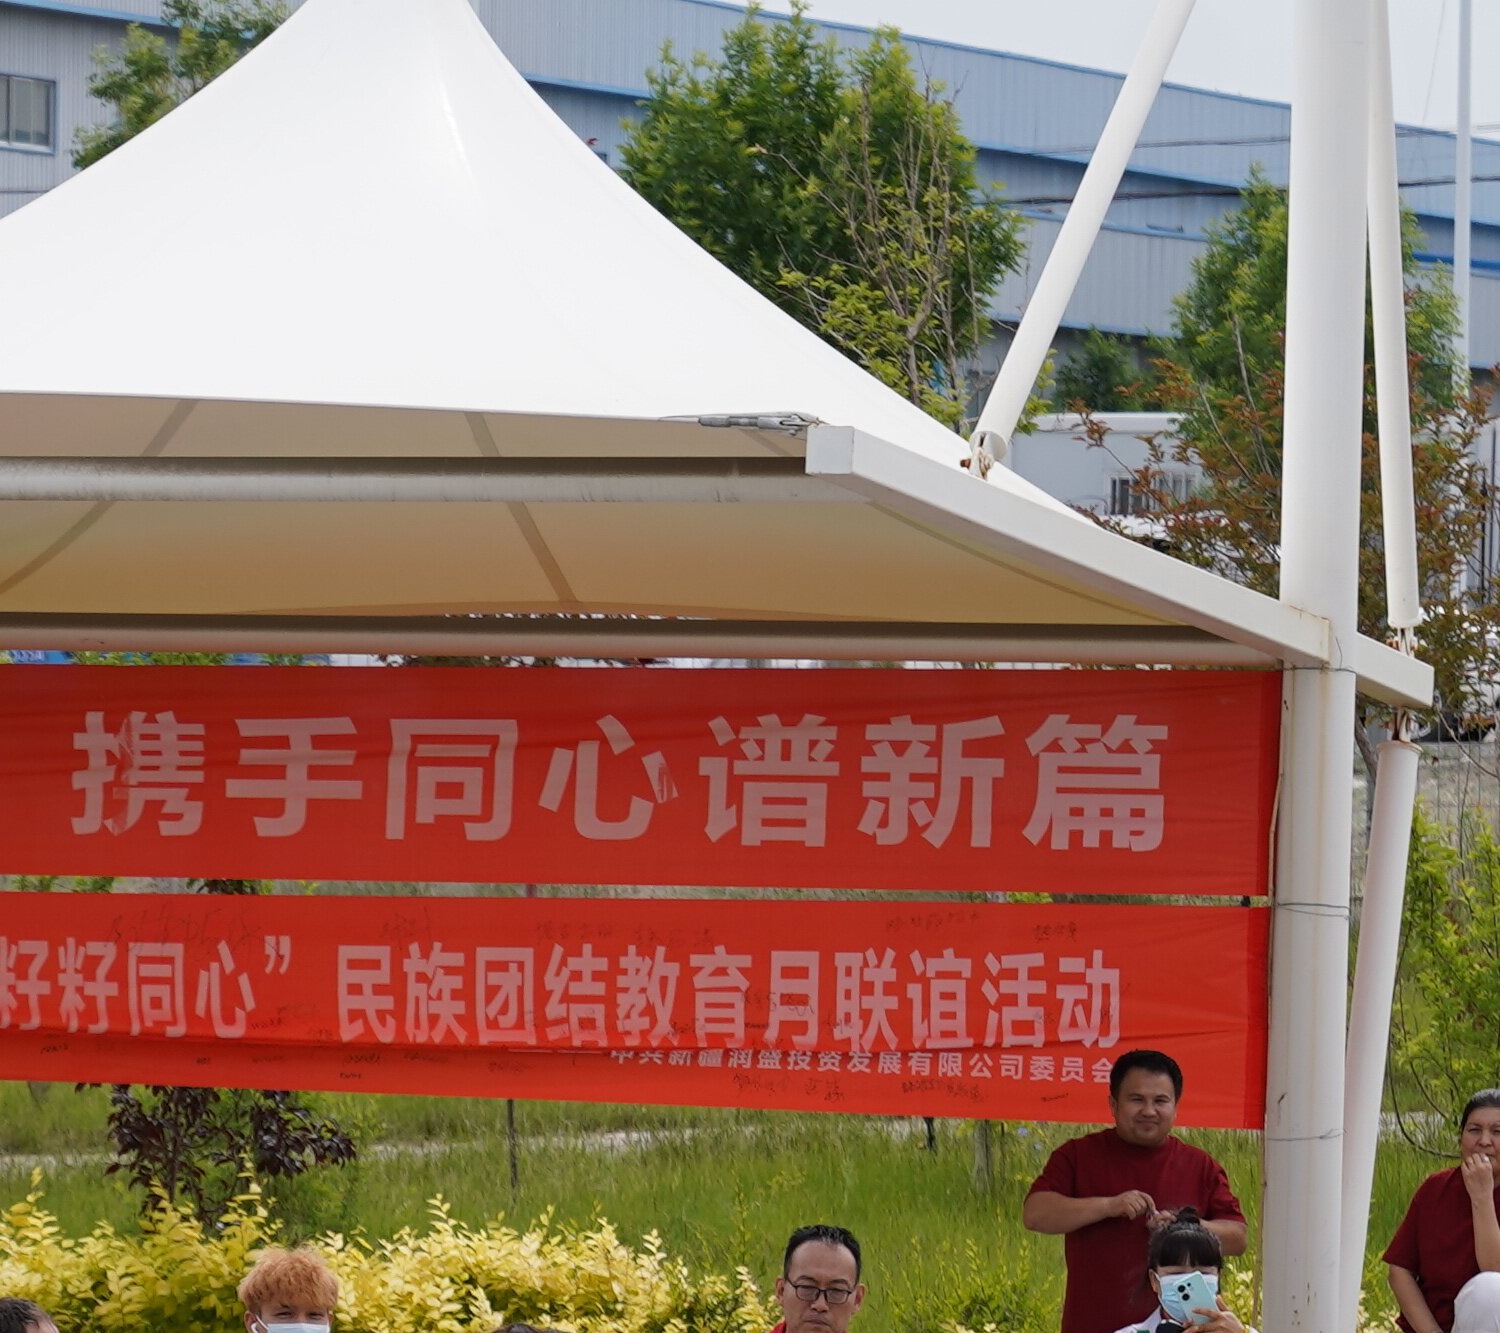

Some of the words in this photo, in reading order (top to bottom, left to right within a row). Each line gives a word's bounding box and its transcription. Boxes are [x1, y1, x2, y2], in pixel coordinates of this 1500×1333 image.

[70, 709, 1170, 853] 携手同心谱新篇
[337, 941, 1121, 1050] 民族团结教育月联谊活动
